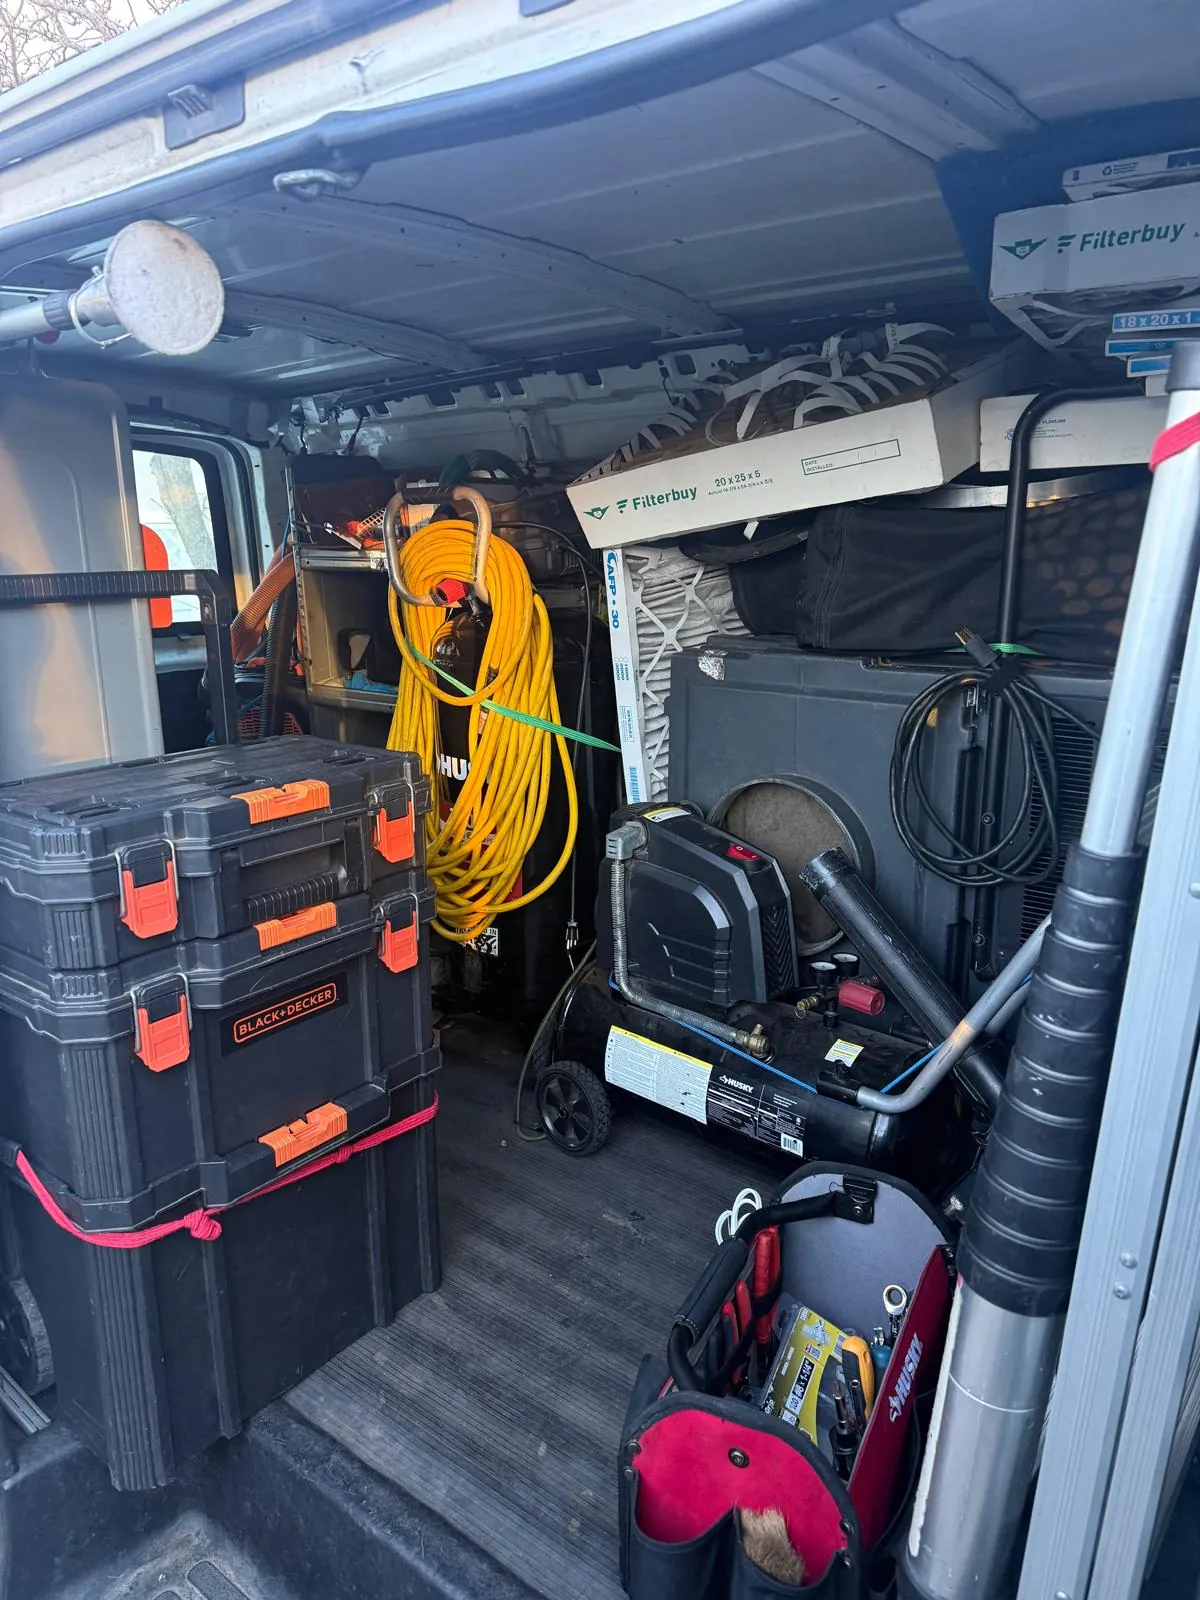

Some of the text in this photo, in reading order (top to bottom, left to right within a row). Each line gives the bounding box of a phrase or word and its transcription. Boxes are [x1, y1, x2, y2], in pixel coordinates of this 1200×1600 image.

[1080, 222, 1186, 252] Filterbuy
[1121, 311, 1192, 328] 18 x 20 x 1
[714, 469, 761, 487] 20 x 25 x 5
[632, 486, 697, 510] Filterbuy
[611, 609, 620, 629] 30
[239, 988, 332, 1036] BLACK+DECKER
[727, 1078, 754, 1094] HUSKY
[895, 1332, 924, 1406] HUSKY
